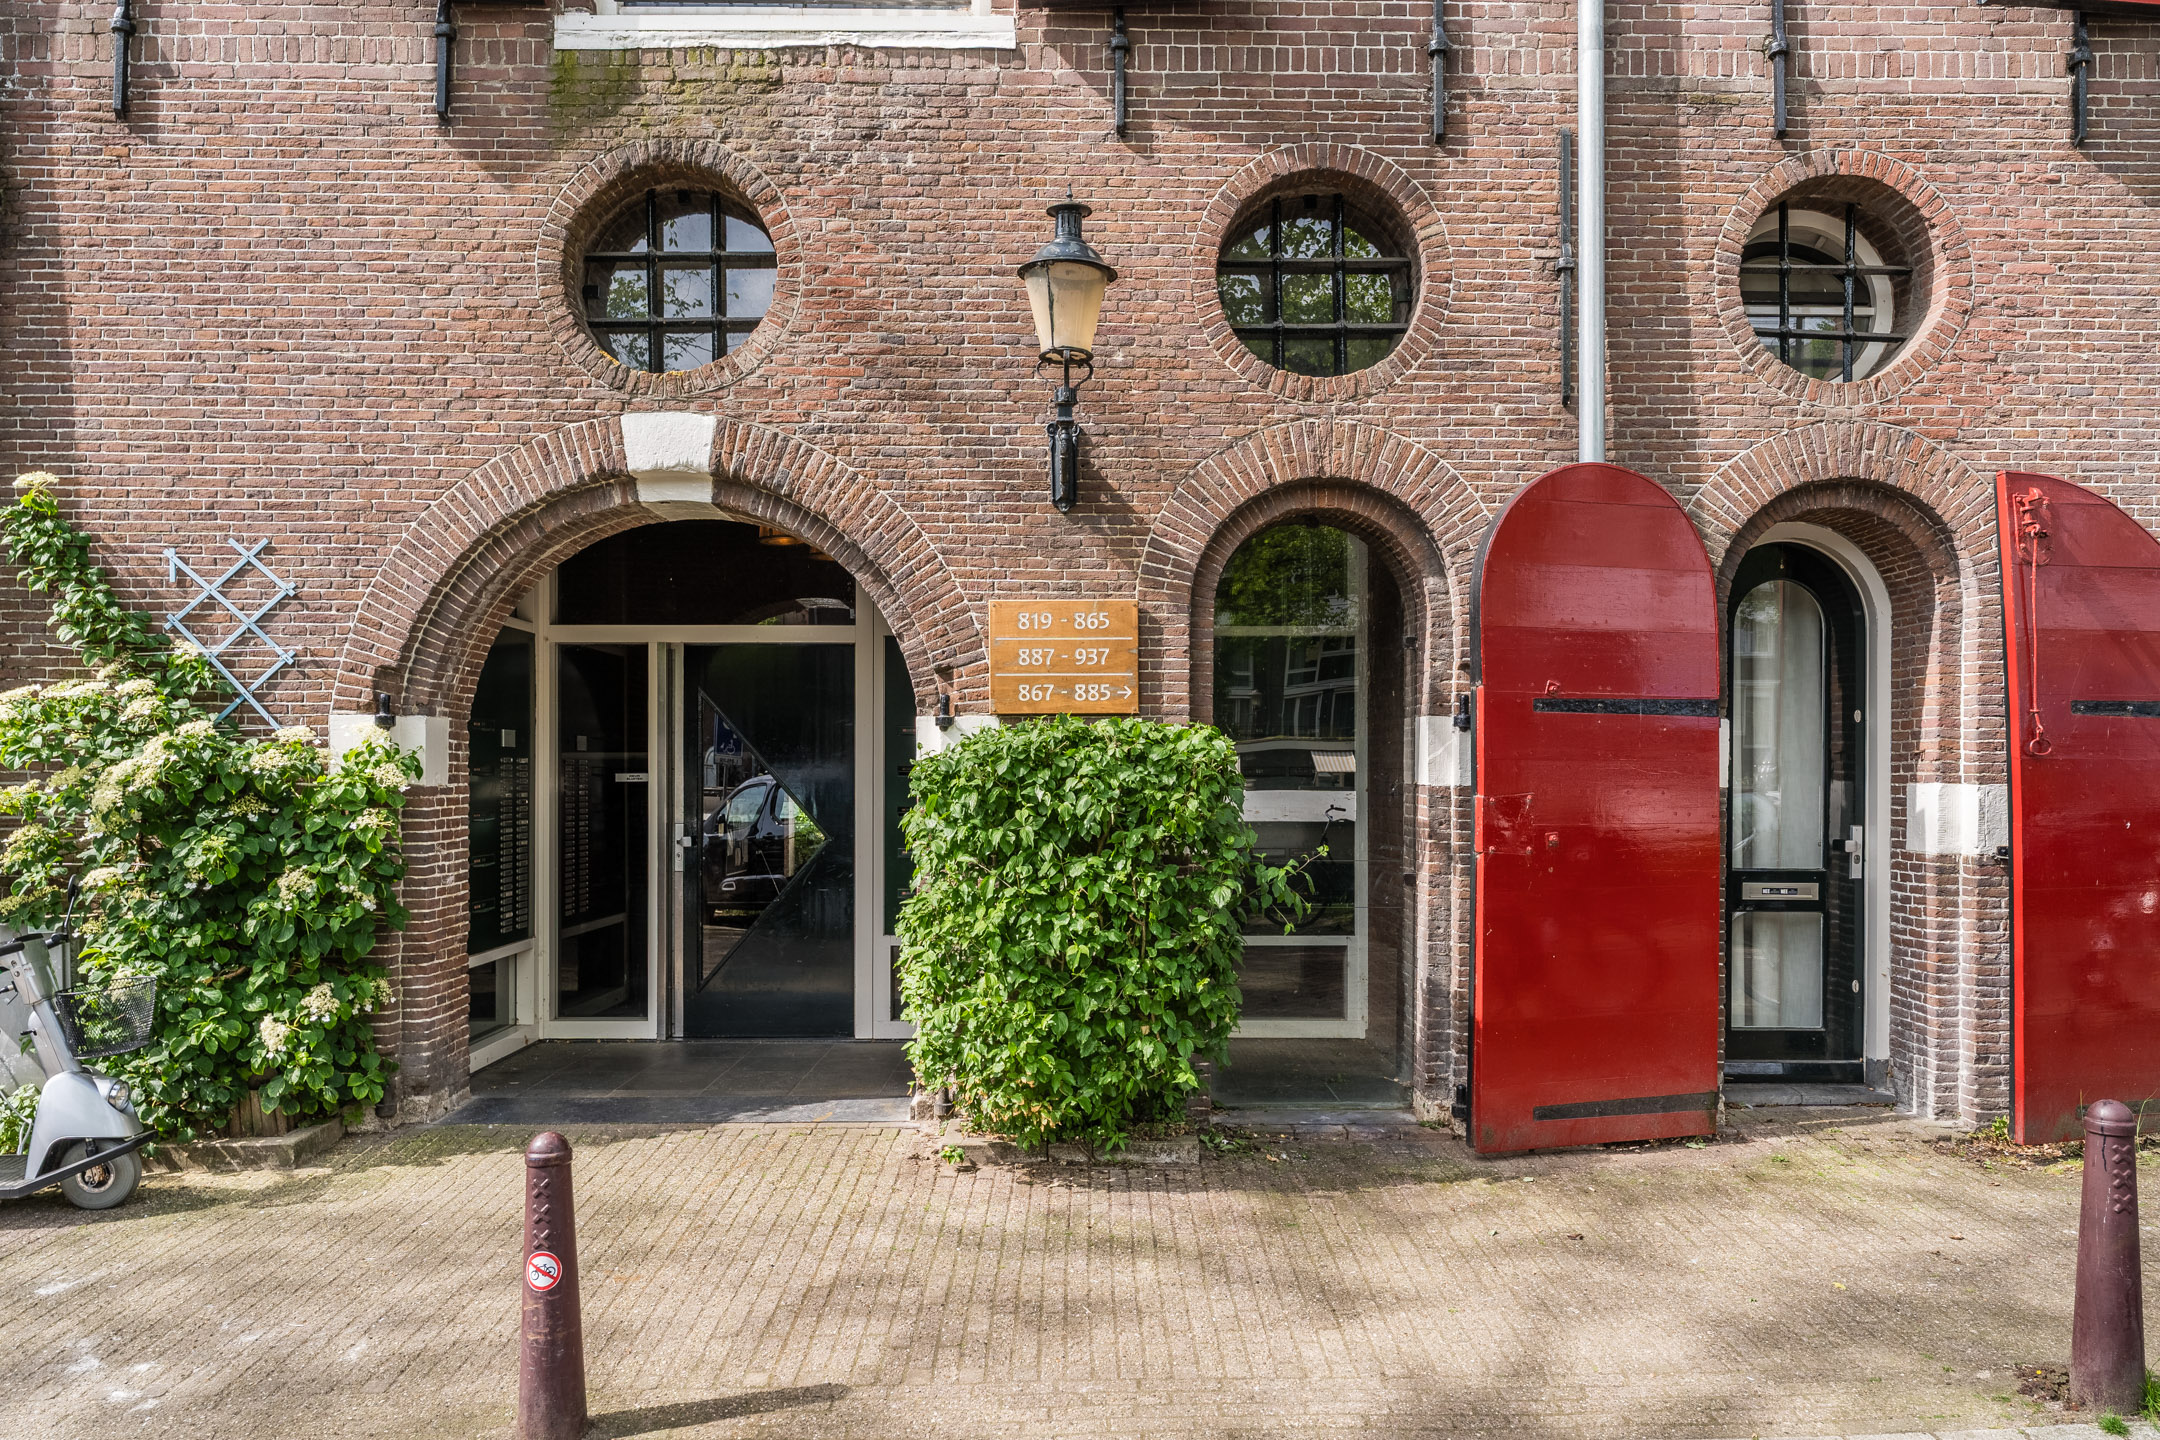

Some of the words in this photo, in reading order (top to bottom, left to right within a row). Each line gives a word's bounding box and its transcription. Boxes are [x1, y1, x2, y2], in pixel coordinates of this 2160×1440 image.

[1017, 612, 1052, 630] 819
[1073, 612, 1110, 630] 865
[1018, 648, 1055, 666] 887
[1074, 648, 1109, 665] 937
[1018, 684, 1054, 701] 867
[1074, 684, 1110, 701] 885
